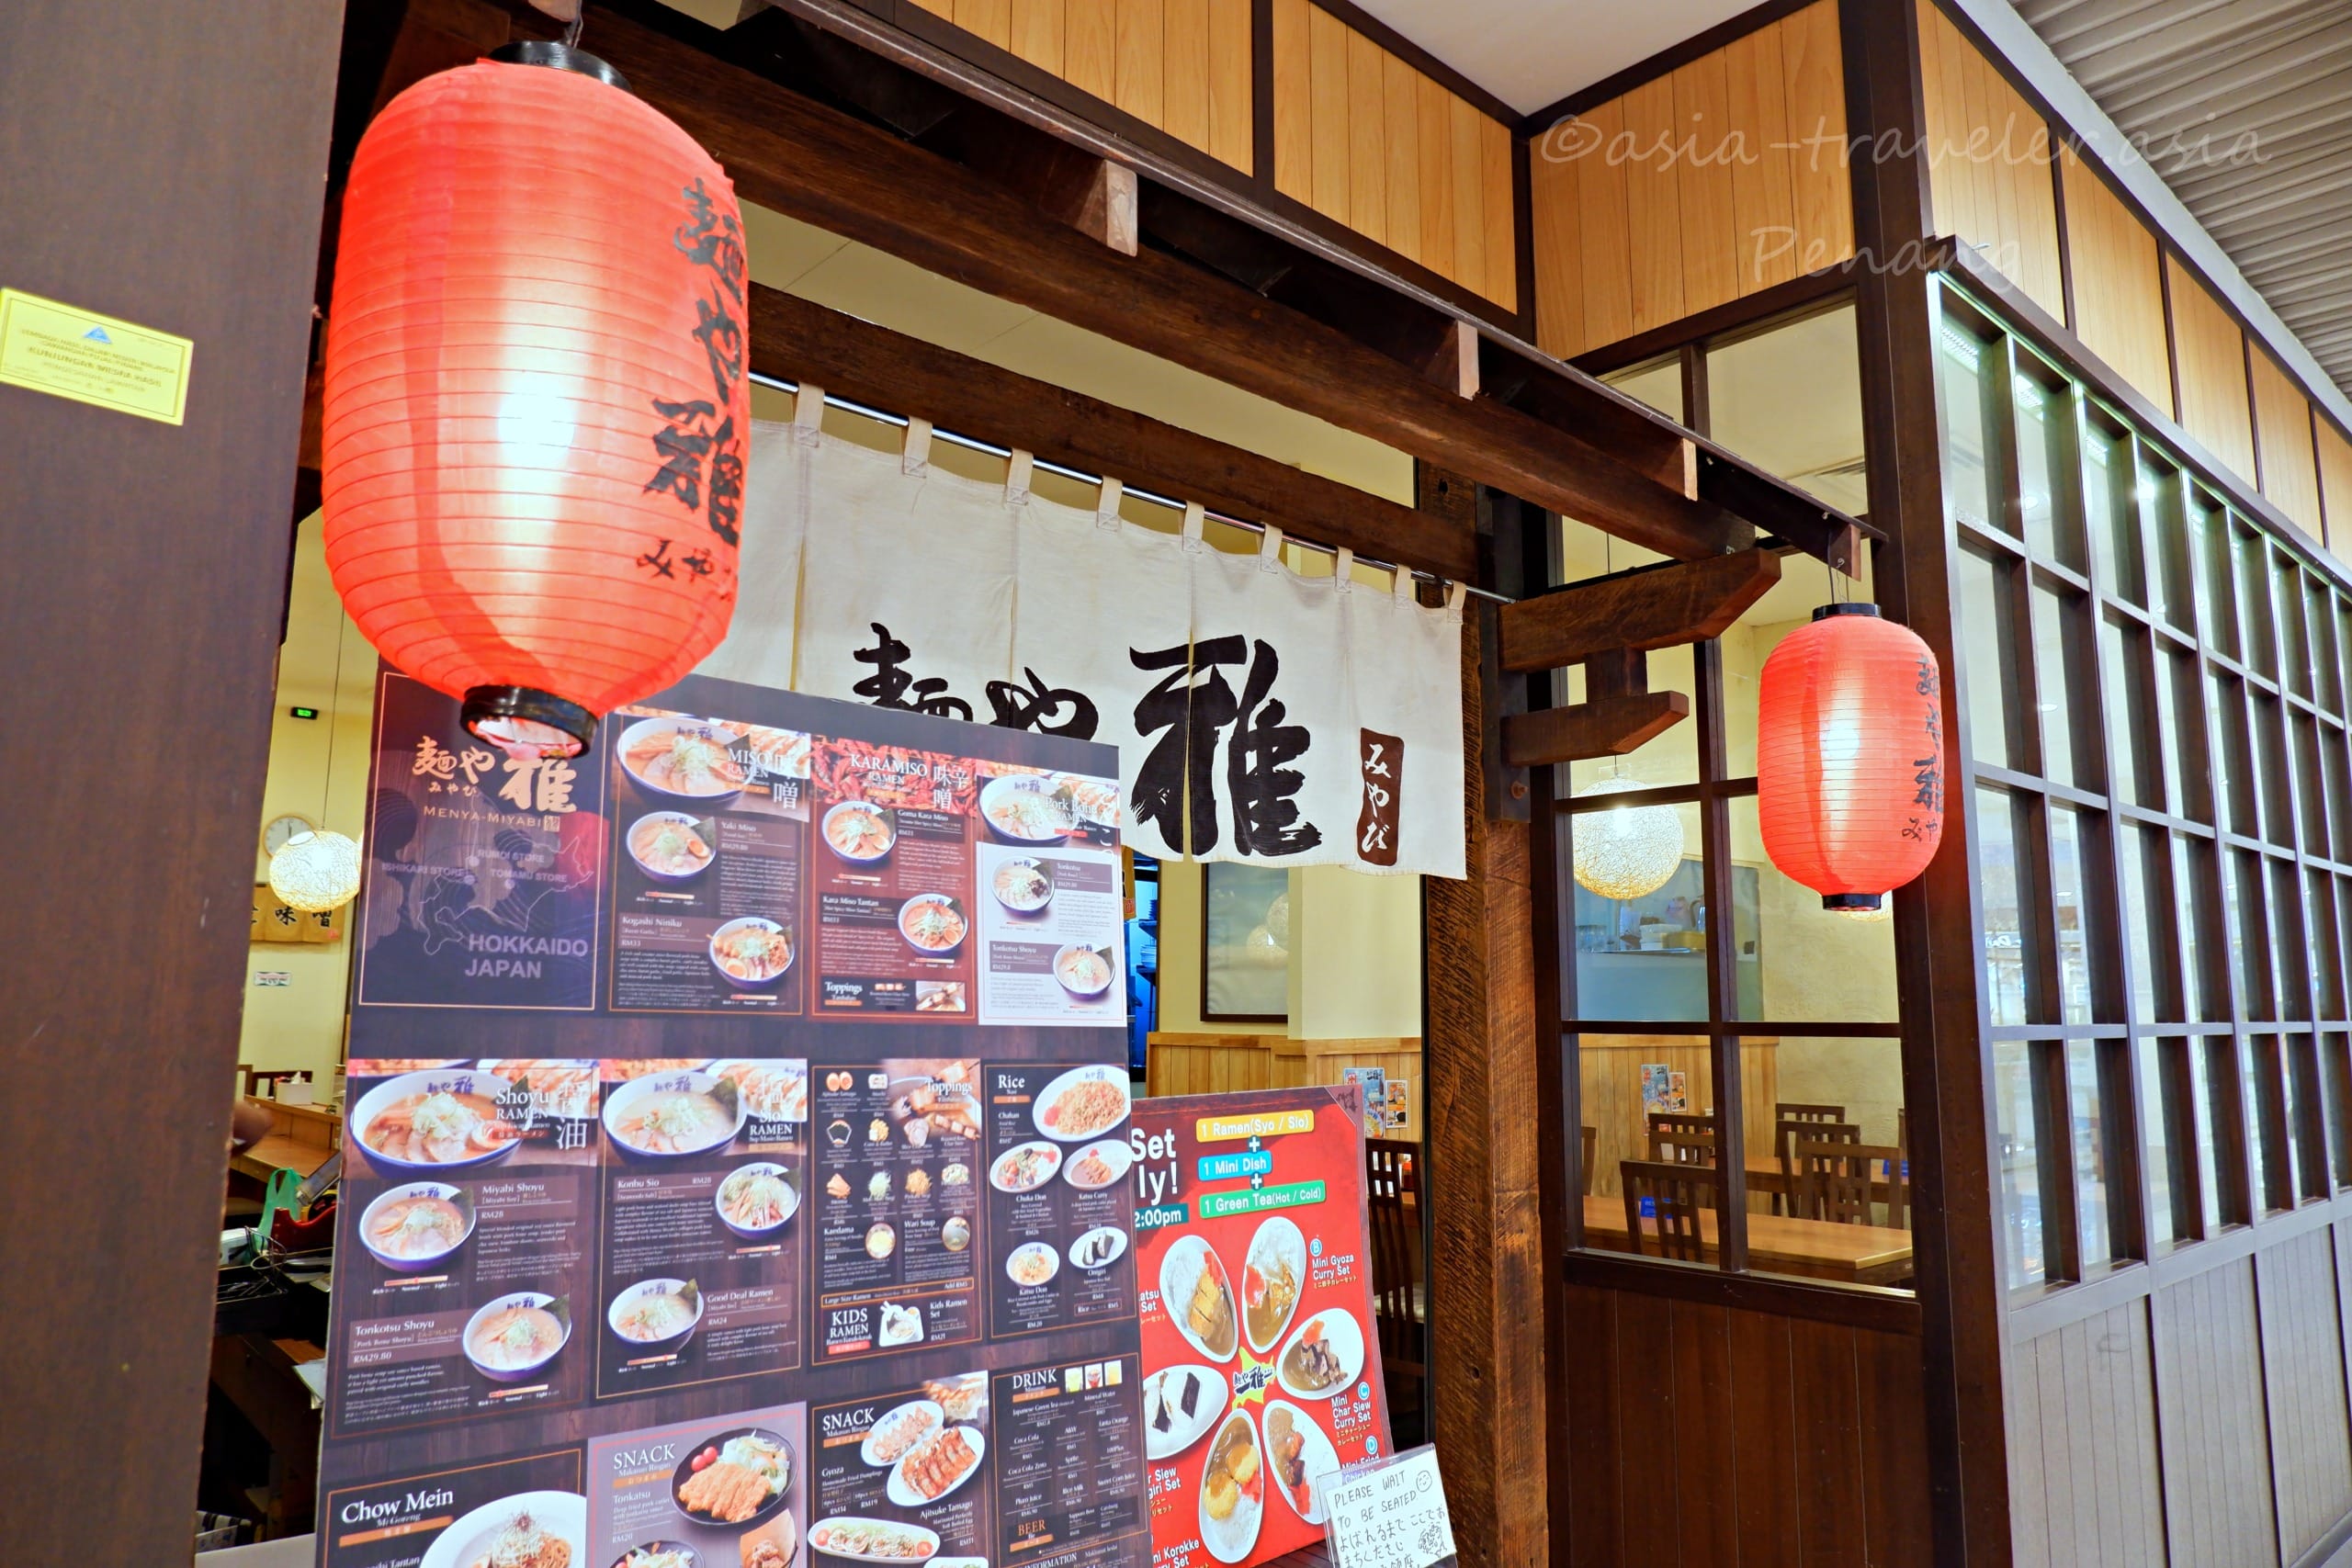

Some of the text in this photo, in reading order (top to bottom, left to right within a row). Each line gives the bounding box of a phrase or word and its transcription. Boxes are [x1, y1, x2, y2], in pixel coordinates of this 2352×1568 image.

[728, 748, 768, 766] MISO
[728, 763, 769, 779] RAMEN
[851, 753, 928, 777] KARAMISO
[412, 736, 577, 813] 麺や雅
[868, 771, 905, 784] RAMEN
[428, 782, 477, 797] みやび
[1362, 742, 1389, 852] みやび
[424, 806, 541, 827] MENYA-MIYABI
[512, 852, 546, 863] STORE
[535, 873, 568, 883] STORE
[622, 917, 653, 927] Kogashi
[469, 933, 588, 957] HOKKAIDO
[465, 958, 542, 978] JAPAN
[825, 982, 863, 995] Toppings
[926, 1080, 973, 1096] Toppings
[998, 1074, 1025, 1089] Rice
[496, 1087, 549, 1108] Shoyu
[496, 1108, 548, 1120] RAMEN
[759, 1109, 781, 1123] Sio
[749, 1123, 793, 1135] RAMEN
[1202, 1124, 1207, 1137] 1
[1131, 1128, 1177, 1162] Set
[1204, 1156, 1267, 1176] 1 Mini Dish
[482, 1182, 545, 1195] Miyabi Shoyu
[617, 1179, 660, 1189] Konbu Sio
[1204, 1187, 1321, 1213] 1 Green Tea(Hot / Cold)
[823, 1226, 854, 1235] Kaedama
[904, 1219, 936, 1228] Wari Soup
[1312, 1254, 1354, 1269] Mini Gyoza
[1313, 1265, 1351, 1280] Curry Set
[707, 1289, 774, 1303] Good Deal Ramen
[930, 1299, 967, 1310] Kids Ramen
[1141, 1301, 1158, 1313] Set
[831, 1308, 868, 1325] KIDS
[930, 1310, 941, 1318] Set
[355, 1320, 435, 1337] Tonkotsu Shoyu
[830, 1323, 869, 1338] RAMEN
[1012, 1368, 1057, 1390] DRINK
[1084, 1390, 1115, 1402] Mineral Water
[1331, 1394, 1348, 1408] Mini
[1012, 1404, 1050, 1416] Japanese Green
[1332, 1401, 1371, 1419] Char Siew
[822, 1407, 875, 1431] SNACK
[1334, 1411, 1372, 1429] Curry Set
[1013, 1433, 1040, 1445] Coca Cola
[614, 1442, 675, 1470] SNACK
[821, 1467, 844, 1477] Gyoza
[1008, 1467, 1022, 1475] Coca
[1022, 1463, 1034, 1472] Cola
[1154, 1467, 1177, 1482] Siew
[1165, 1476, 1182, 1492] Set
[1334, 1470, 1406, 1509] PLEASE WAIT
[614, 1491, 650, 1505] Tonkatsu
[342, 1488, 455, 1525] Chow Mein
[920, 1501, 973, 1520] Ajitsuke Tamago
[1337, 1515, 1351, 1531] TO
[1361, 1506, 1374, 1523] BE
[1018, 1519, 1046, 1537] BEER
[1163, 1539, 1200, 1560] Korokke
[1173, 1554, 1190, 1568] Set
